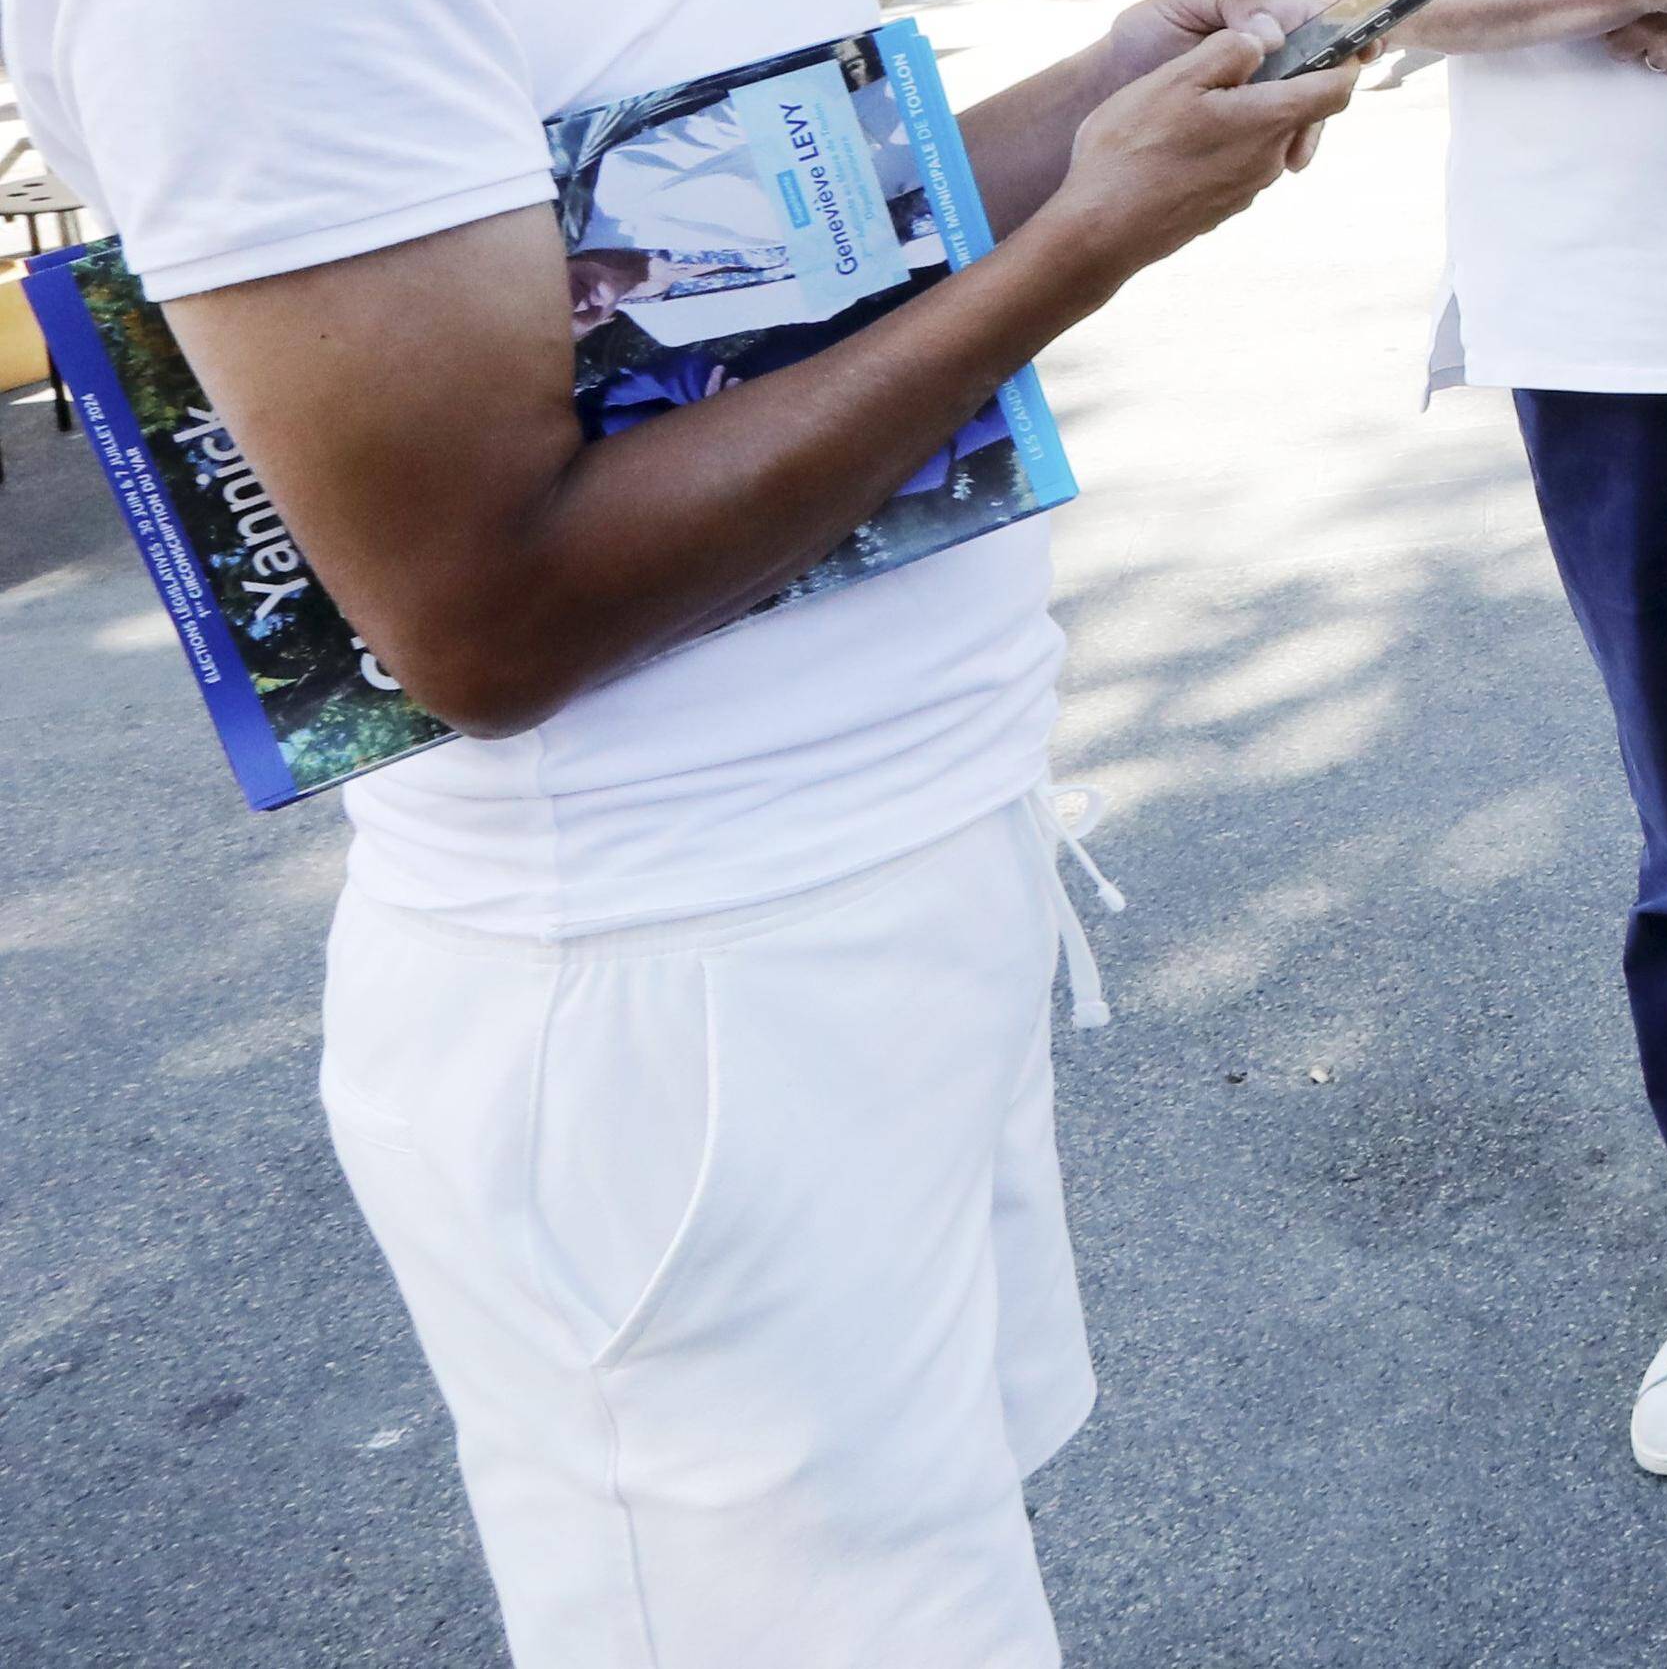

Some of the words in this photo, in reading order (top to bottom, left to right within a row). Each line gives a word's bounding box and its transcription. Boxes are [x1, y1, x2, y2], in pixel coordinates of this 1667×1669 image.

[893, 53, 923, 116] TOULON
[780, 104, 819, 162] LEVY
[913, 121, 932, 140] DE
[922, 143, 959, 229] MUNICIPALE
[810, 166, 858, 276] Geneviève
[81, 393, 105, 422] 2024
[94, 424, 125, 466] JUILLET
[126, 446, 147, 472] VAR
[1023, 434, 1045, 461] LES
[114, 470, 130, 479] 7
[137, 473, 156, 493] DU
[124, 490, 148, 517] JUIN
[137, 519, 155, 536] 30
[148, 493, 202, 599] CIRCONSCRIPTION
[148, 542, 192, 620] LÉGISLATIVES
[183, 620, 221, 684] ÉLECTIONS
